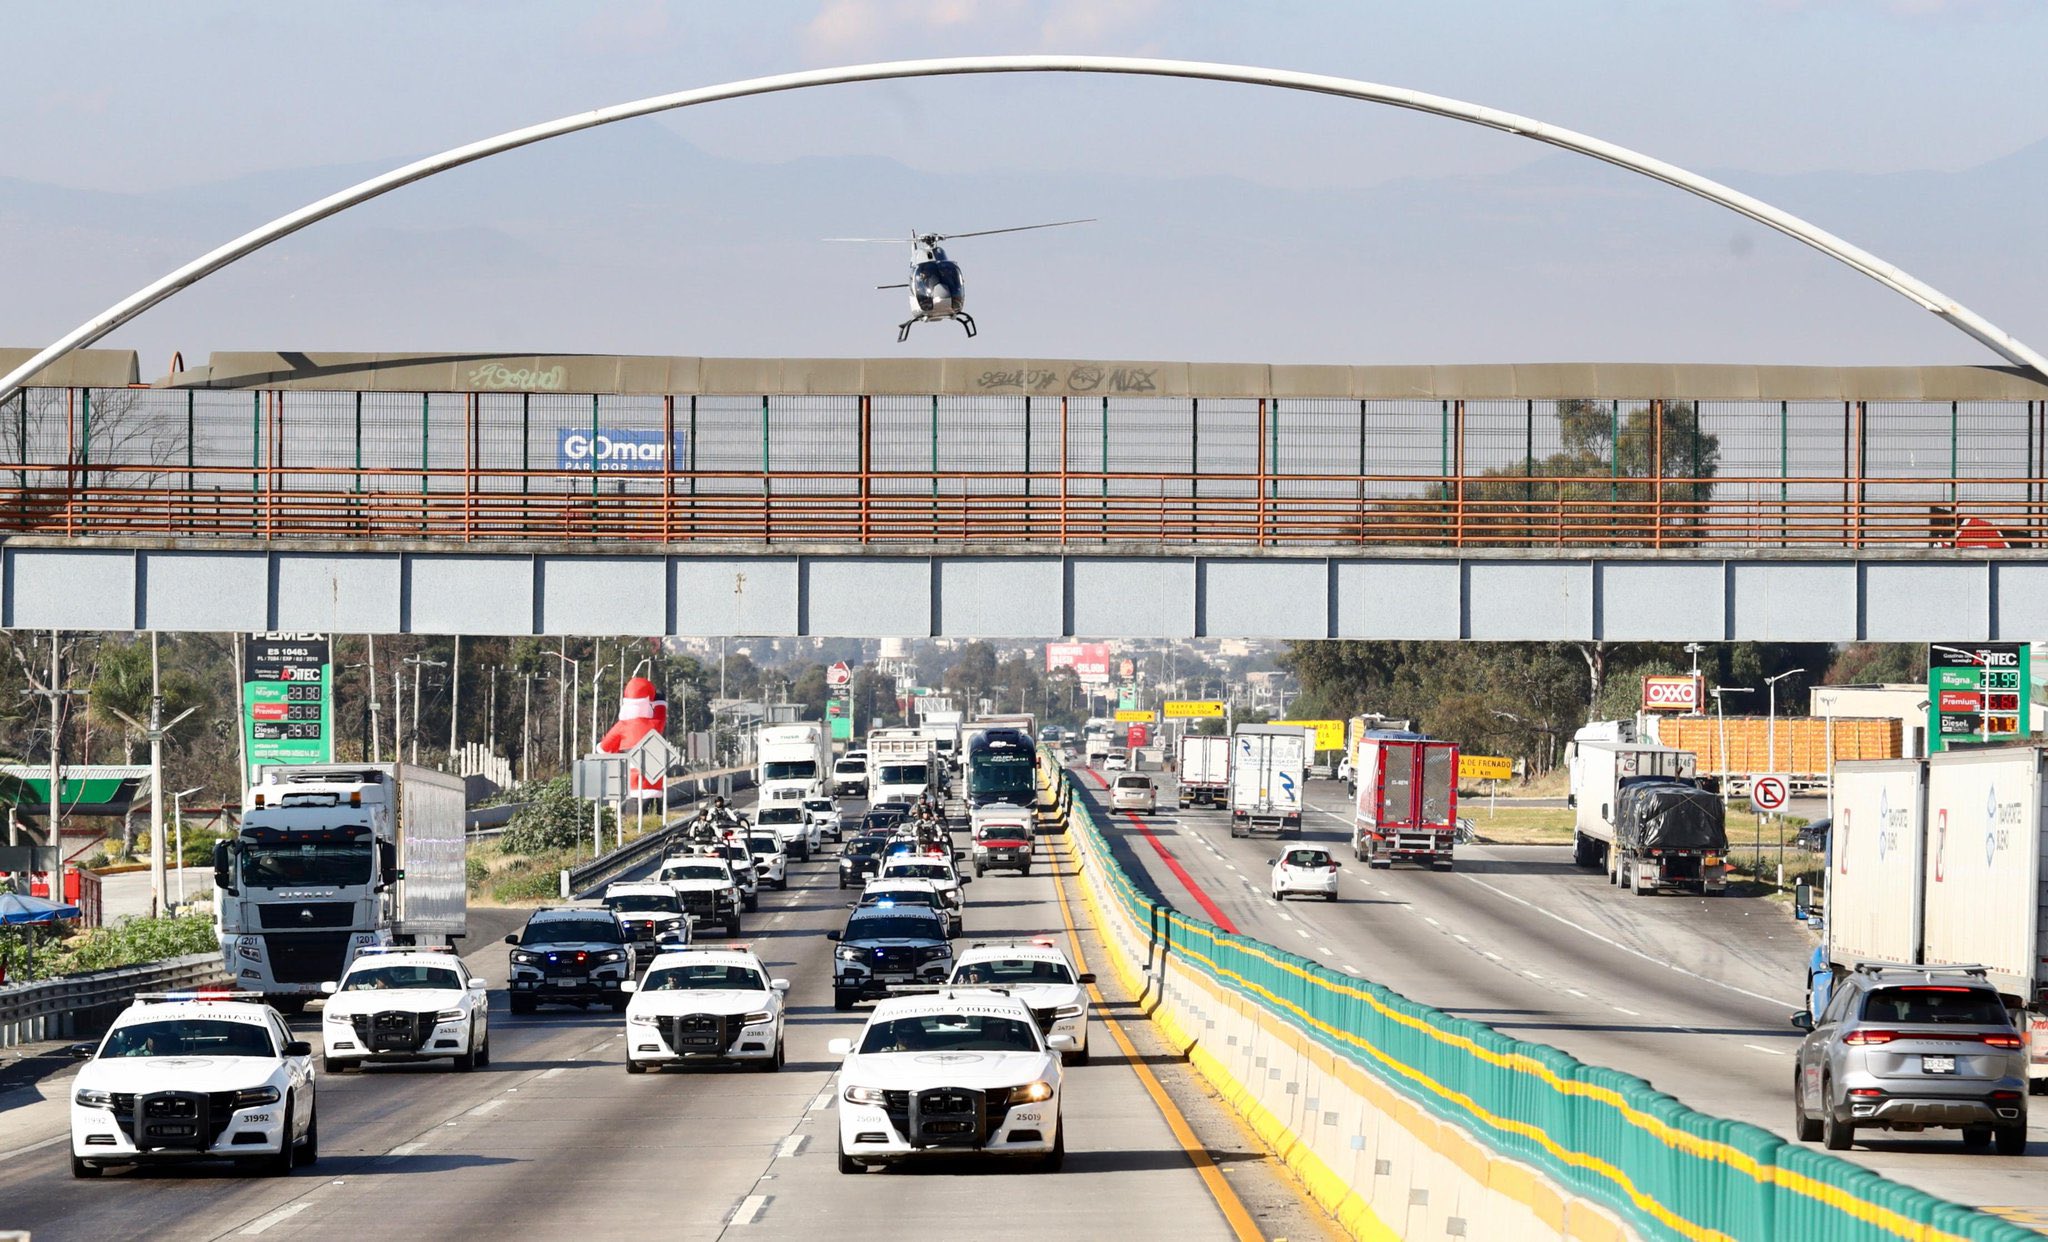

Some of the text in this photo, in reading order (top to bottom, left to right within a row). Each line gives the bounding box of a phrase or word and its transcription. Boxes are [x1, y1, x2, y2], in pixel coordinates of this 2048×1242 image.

[1942, 676, 1971, 686] Magna
[1649, 684, 1694, 701] OXXO
[1479, 760, 1511, 768] FRENADO
[355, 935, 374, 944] 1201
[243, 1114, 270, 1123] 31992
[1016, 1113, 1041, 1121] 25019
